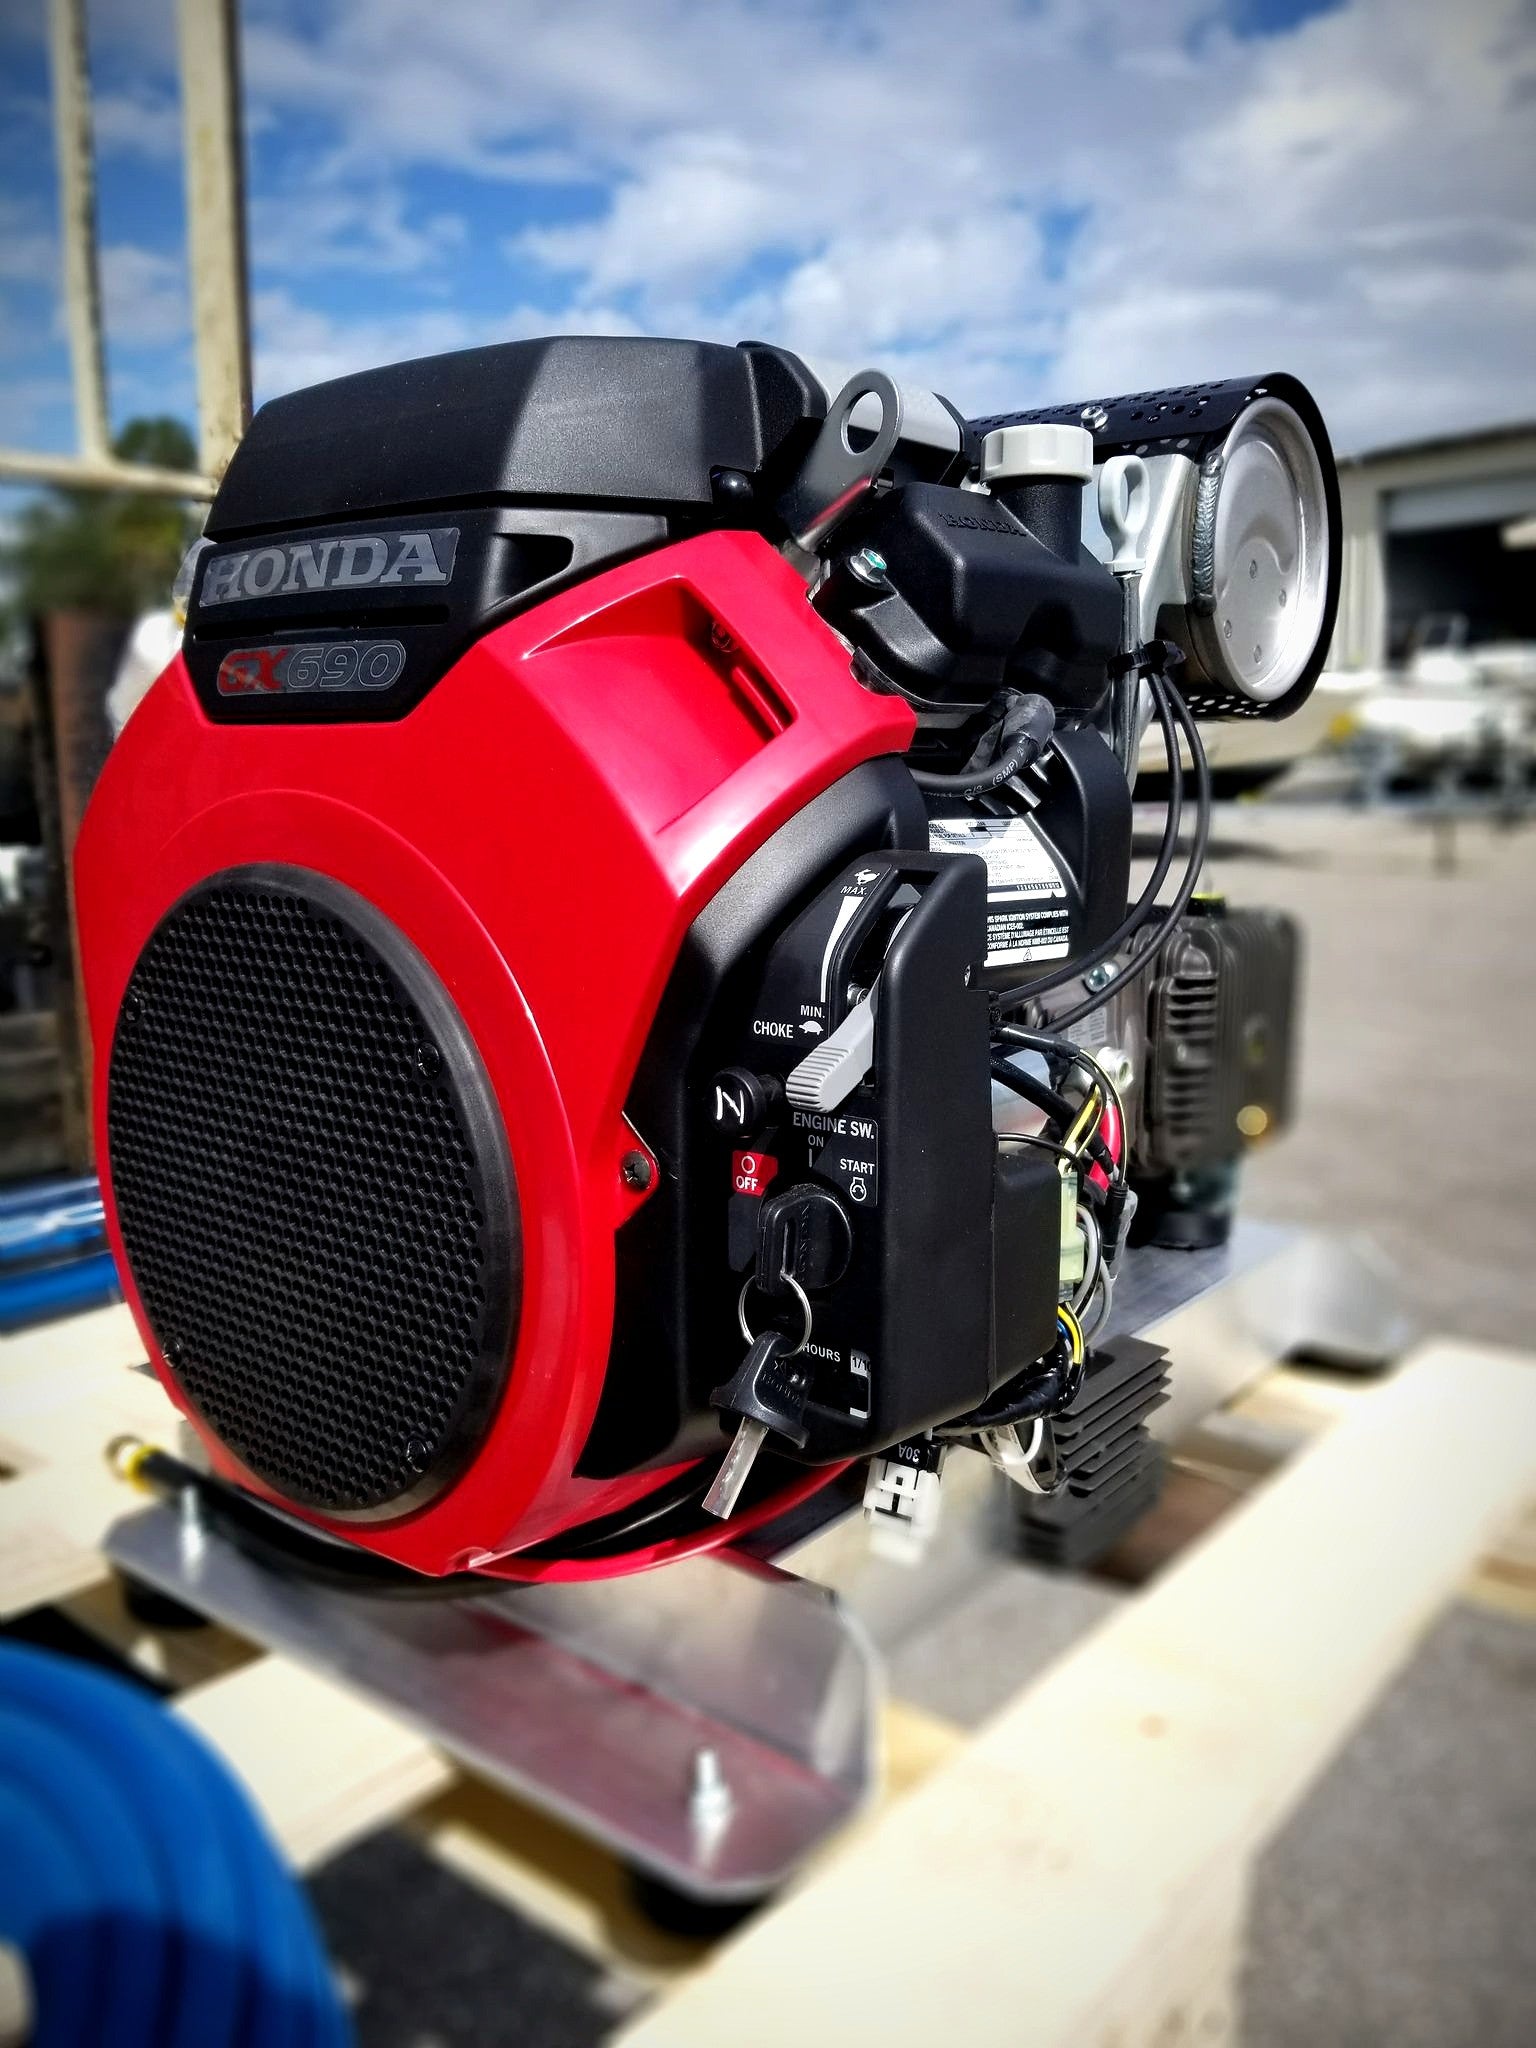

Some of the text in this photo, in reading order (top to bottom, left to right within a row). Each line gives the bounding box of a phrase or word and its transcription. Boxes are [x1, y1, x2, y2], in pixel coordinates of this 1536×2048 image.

[204, 533, 448, 600] HONDA
[840, 885, 868, 896] MAX.
[800, 1004, 825, 1018] MIN.
[753, 1020, 794, 1039] CHOKE
[793, 1111, 875, 1140] ENGINE SW.
[807, 1134, 824, 1148] ON
[840, 1158, 875, 1175] START
[736, 1175, 759, 1191] OFF
[803, 1342, 841, 1362] HOURS
[898, 1444, 920, 1463] 30A
